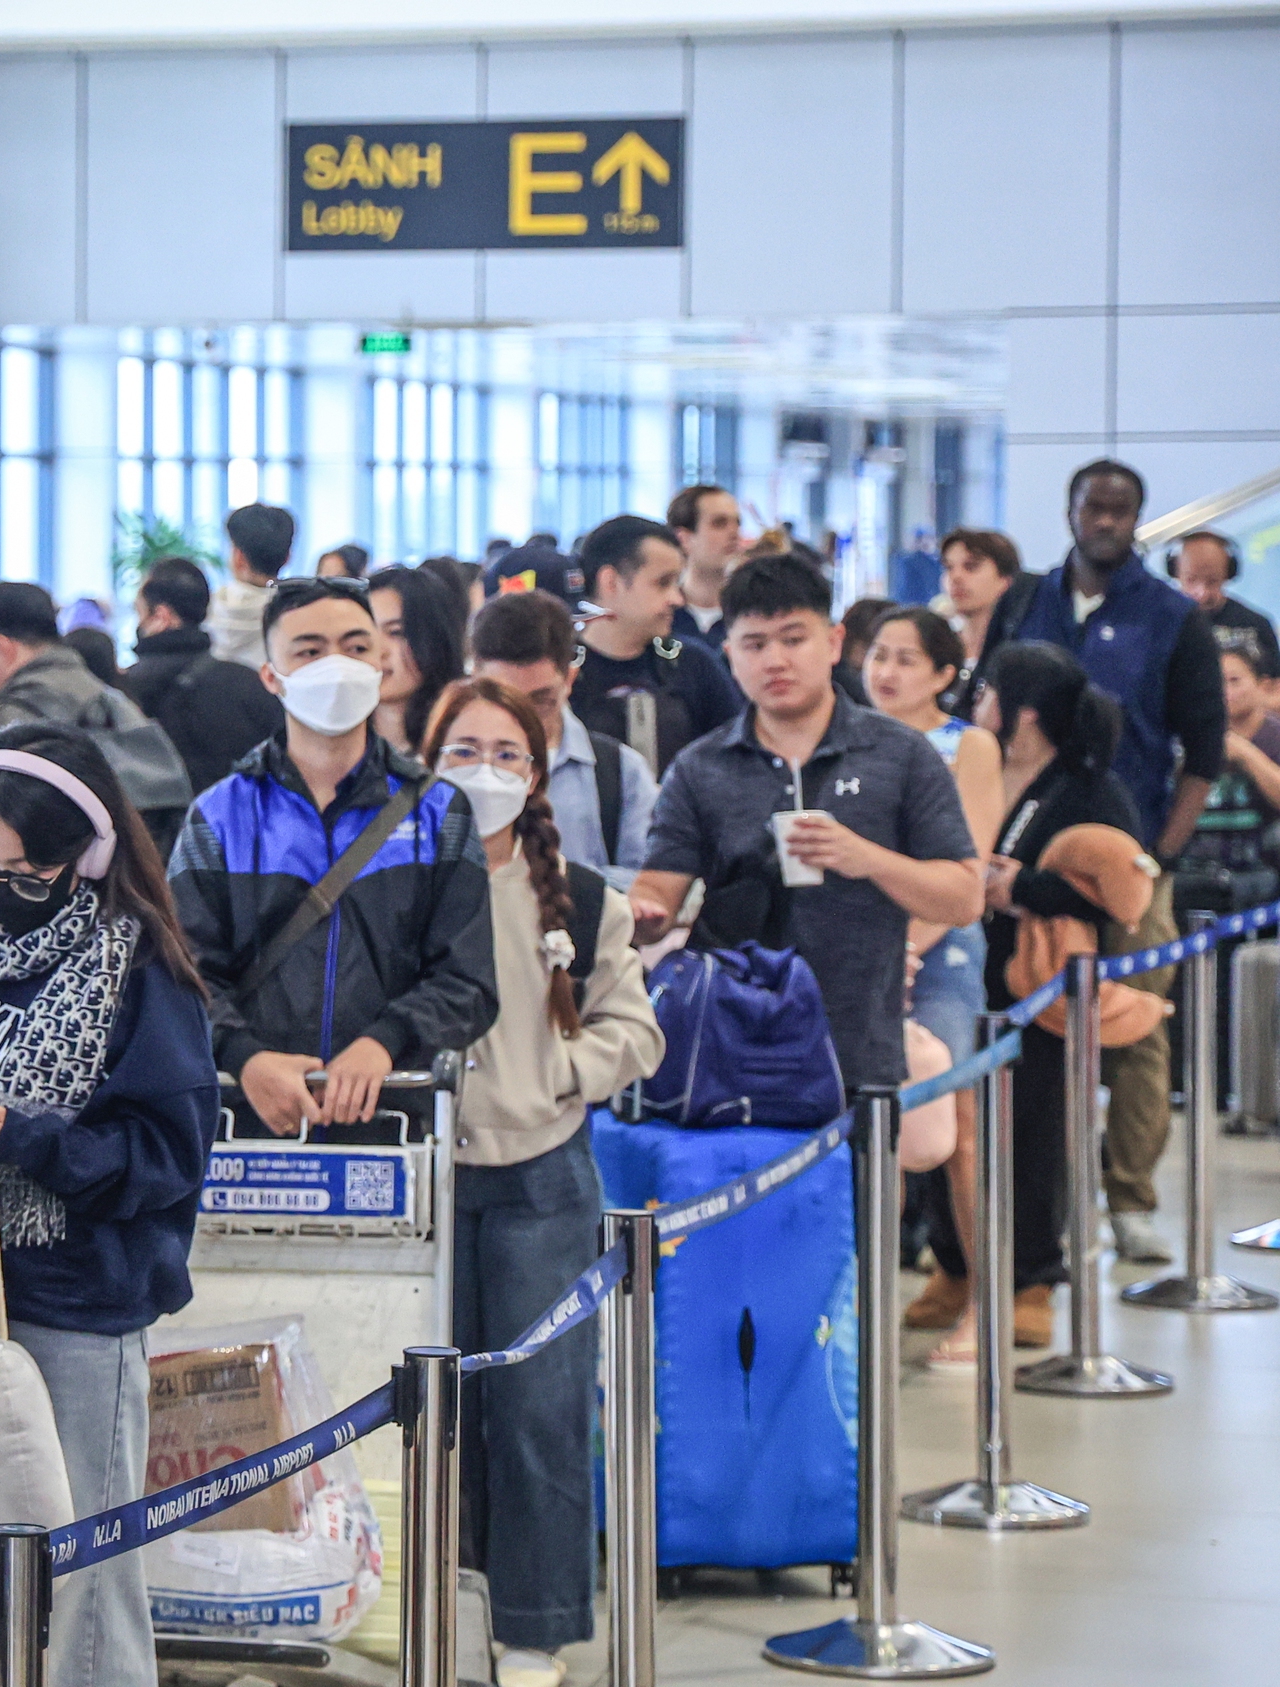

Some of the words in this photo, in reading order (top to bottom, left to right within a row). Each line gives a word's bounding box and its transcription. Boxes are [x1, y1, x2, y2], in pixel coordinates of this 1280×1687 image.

[508, 131, 588, 236] E
[302, 199, 404, 242] Lobby
[272, 1442, 315, 1480] AIRPORT
